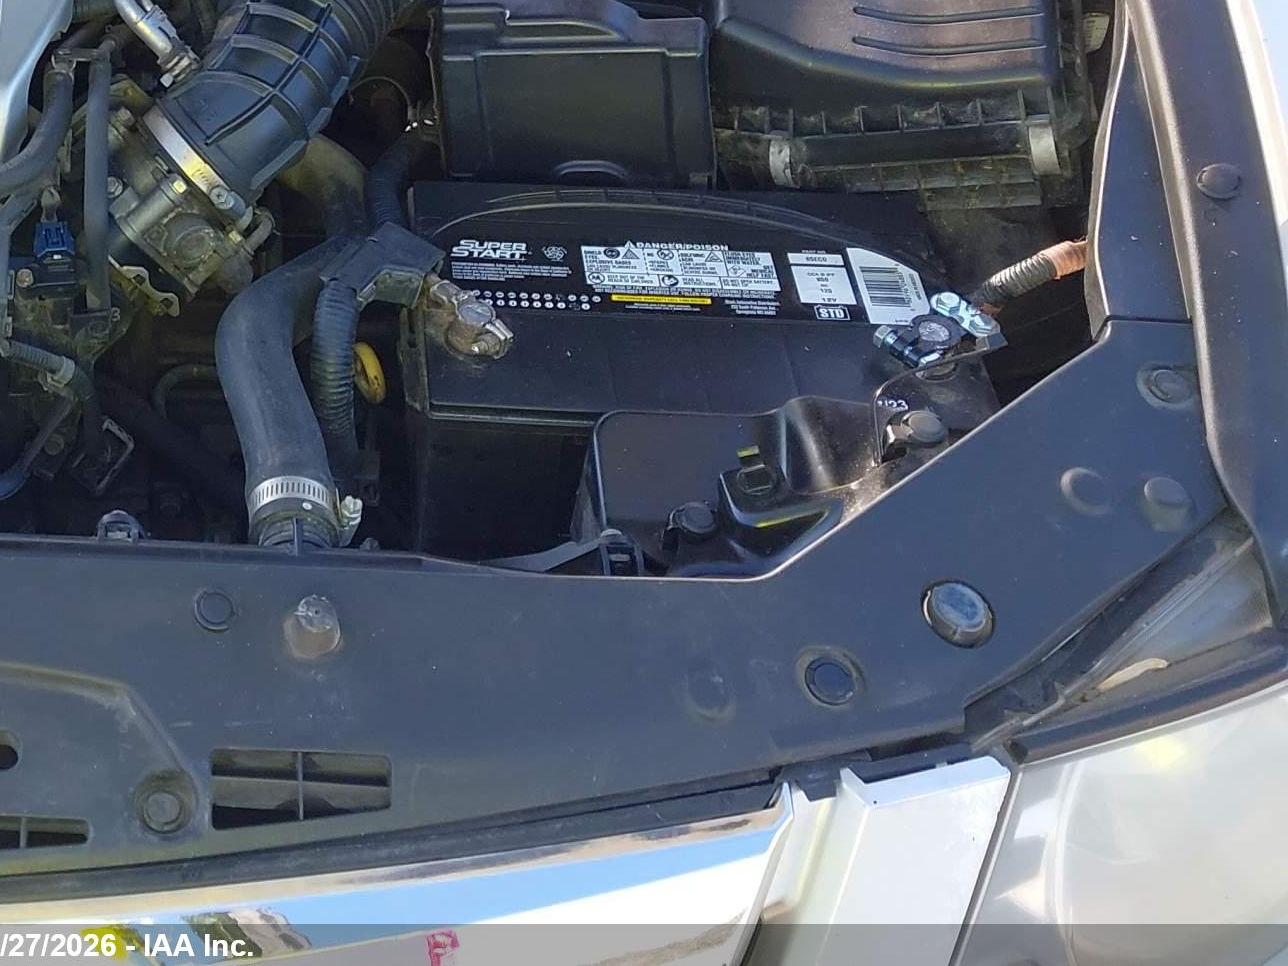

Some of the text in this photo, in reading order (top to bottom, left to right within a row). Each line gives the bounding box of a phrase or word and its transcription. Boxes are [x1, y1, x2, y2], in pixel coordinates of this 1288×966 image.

[459, 239, 527, 250] SUPER
[636, 242, 729, 251] DANGER/POISON
[450, 246, 528, 259] START
[818, 308, 845, 319] STD
